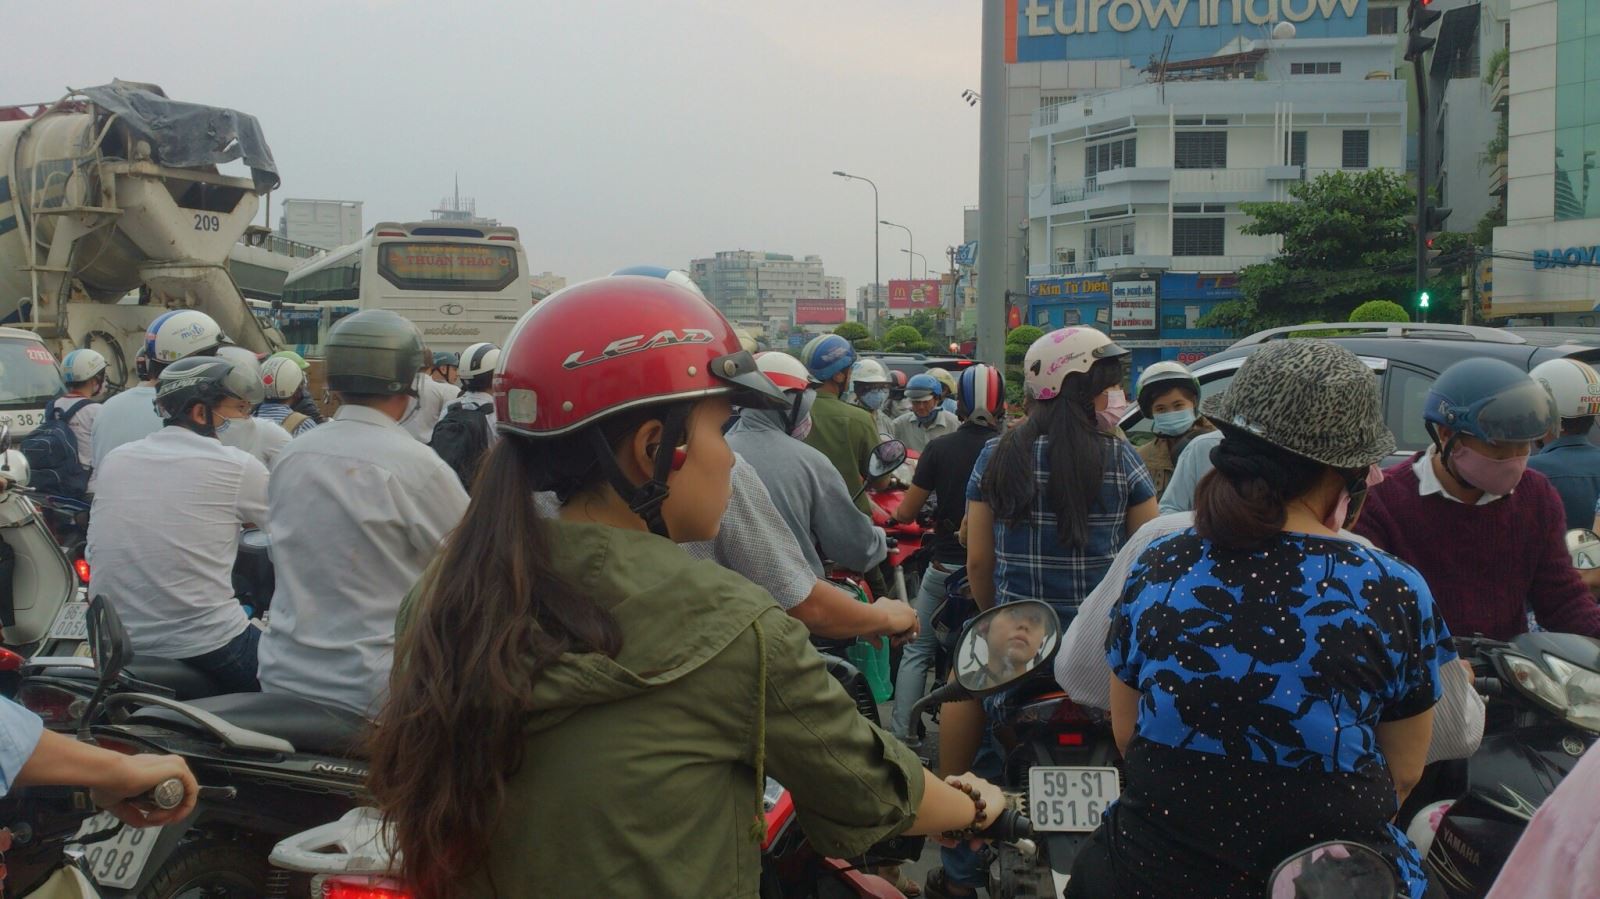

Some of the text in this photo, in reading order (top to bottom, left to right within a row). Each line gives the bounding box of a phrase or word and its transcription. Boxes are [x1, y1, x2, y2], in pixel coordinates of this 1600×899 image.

[194, 214, 220, 232] 209
[1039, 283, 1061, 296] Kim
[562, 329, 715, 370] LEAD
[1043, 771, 1103, 798] 59-S1
[1036, 800, 1107, 827] 851.6
[1443, 828, 1480, 866] YAMAHA
